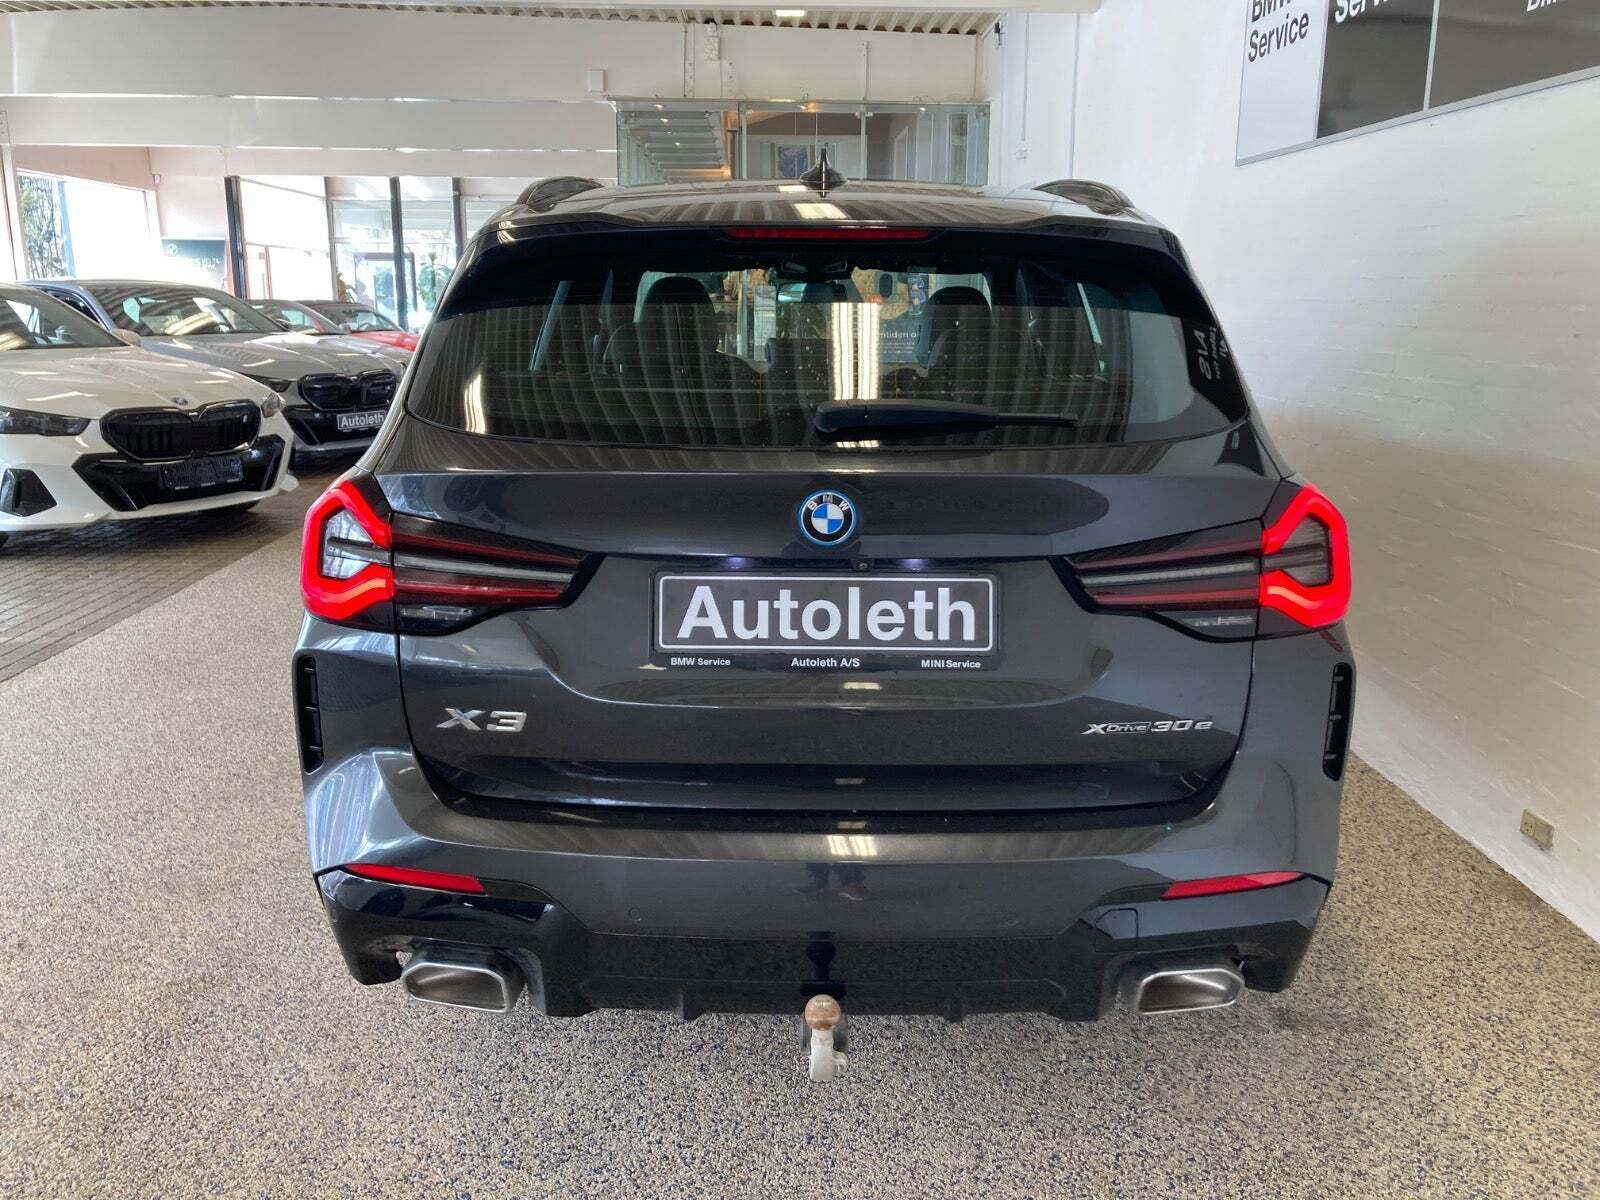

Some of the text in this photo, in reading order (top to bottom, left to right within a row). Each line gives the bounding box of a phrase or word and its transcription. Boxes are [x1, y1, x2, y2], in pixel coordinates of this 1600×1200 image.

[1248, 13, 1309, 62] Service
[341, 413, 384, 428] Autoleth
[807, 494, 850, 511] BMW
[677, 585, 975, 641] Autoleth
[670, 657, 731, 666] BMW Service
[791, 657, 861, 667] Autoleth A/S
[435, 707, 527, 732] X3
